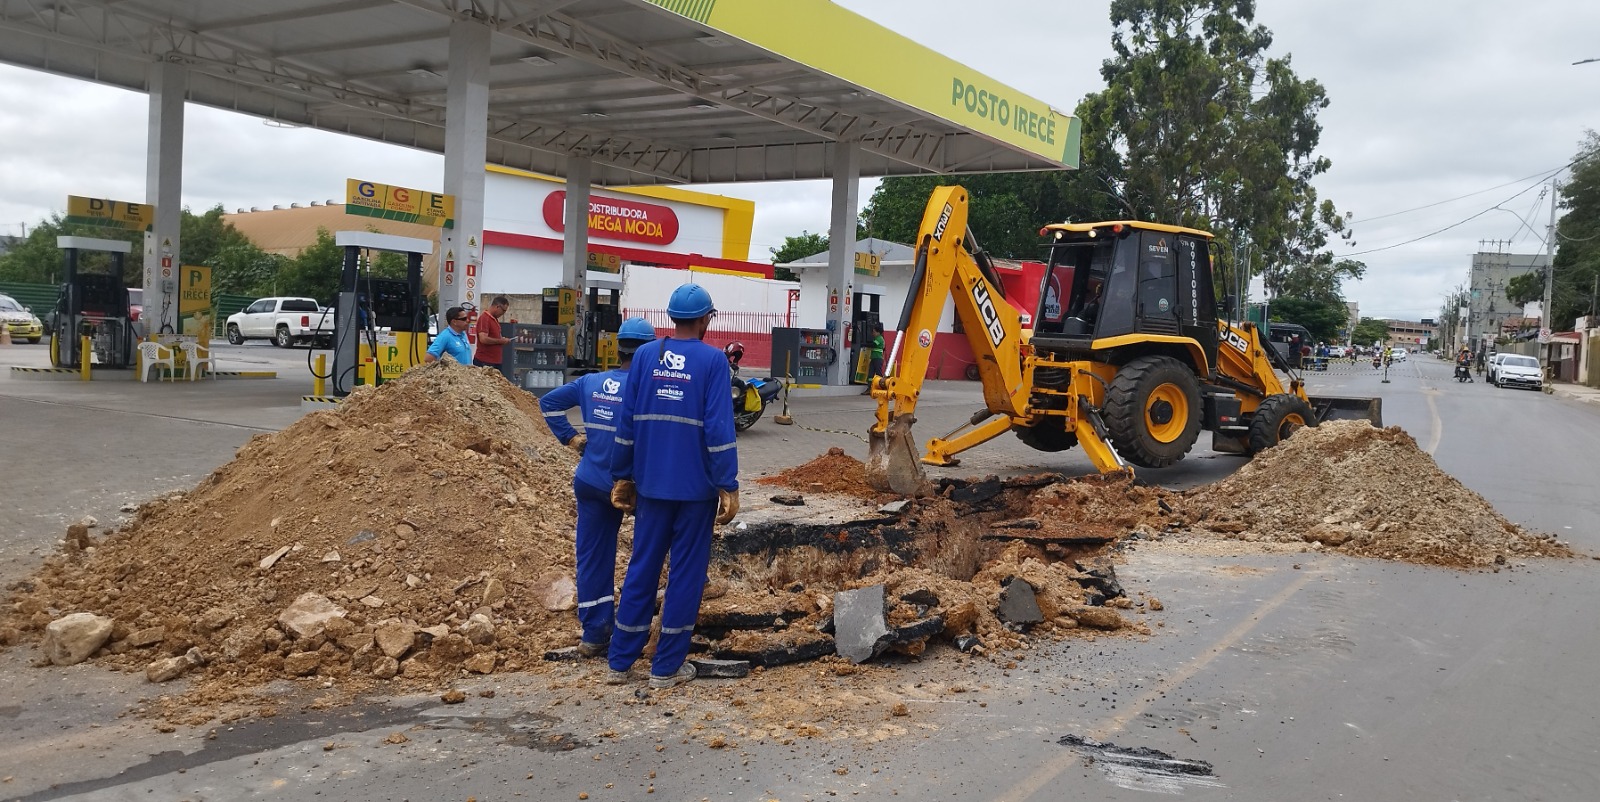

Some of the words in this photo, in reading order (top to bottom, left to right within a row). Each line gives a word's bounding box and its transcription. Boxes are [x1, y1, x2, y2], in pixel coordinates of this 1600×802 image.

[952, 77, 1010, 126] POSTO
[1013, 105, 1056, 145] IRECÊ
[90, 198, 104, 210] D
[127, 203, 139, 215] E
[359, 182, 375, 198] G
[393, 188, 409, 202] G
[431, 194, 443, 209] E
[588, 203, 648, 220] DISTRIBUIDORA
[588, 214, 623, 233] MEGA
[625, 218, 663, 238] MODA
[870, 255, 877, 265] D
[1148, 244, 1169, 254] SEVEN
[974, 286, 1004, 346] JCB
[1220, 329, 1248, 353] JCB
